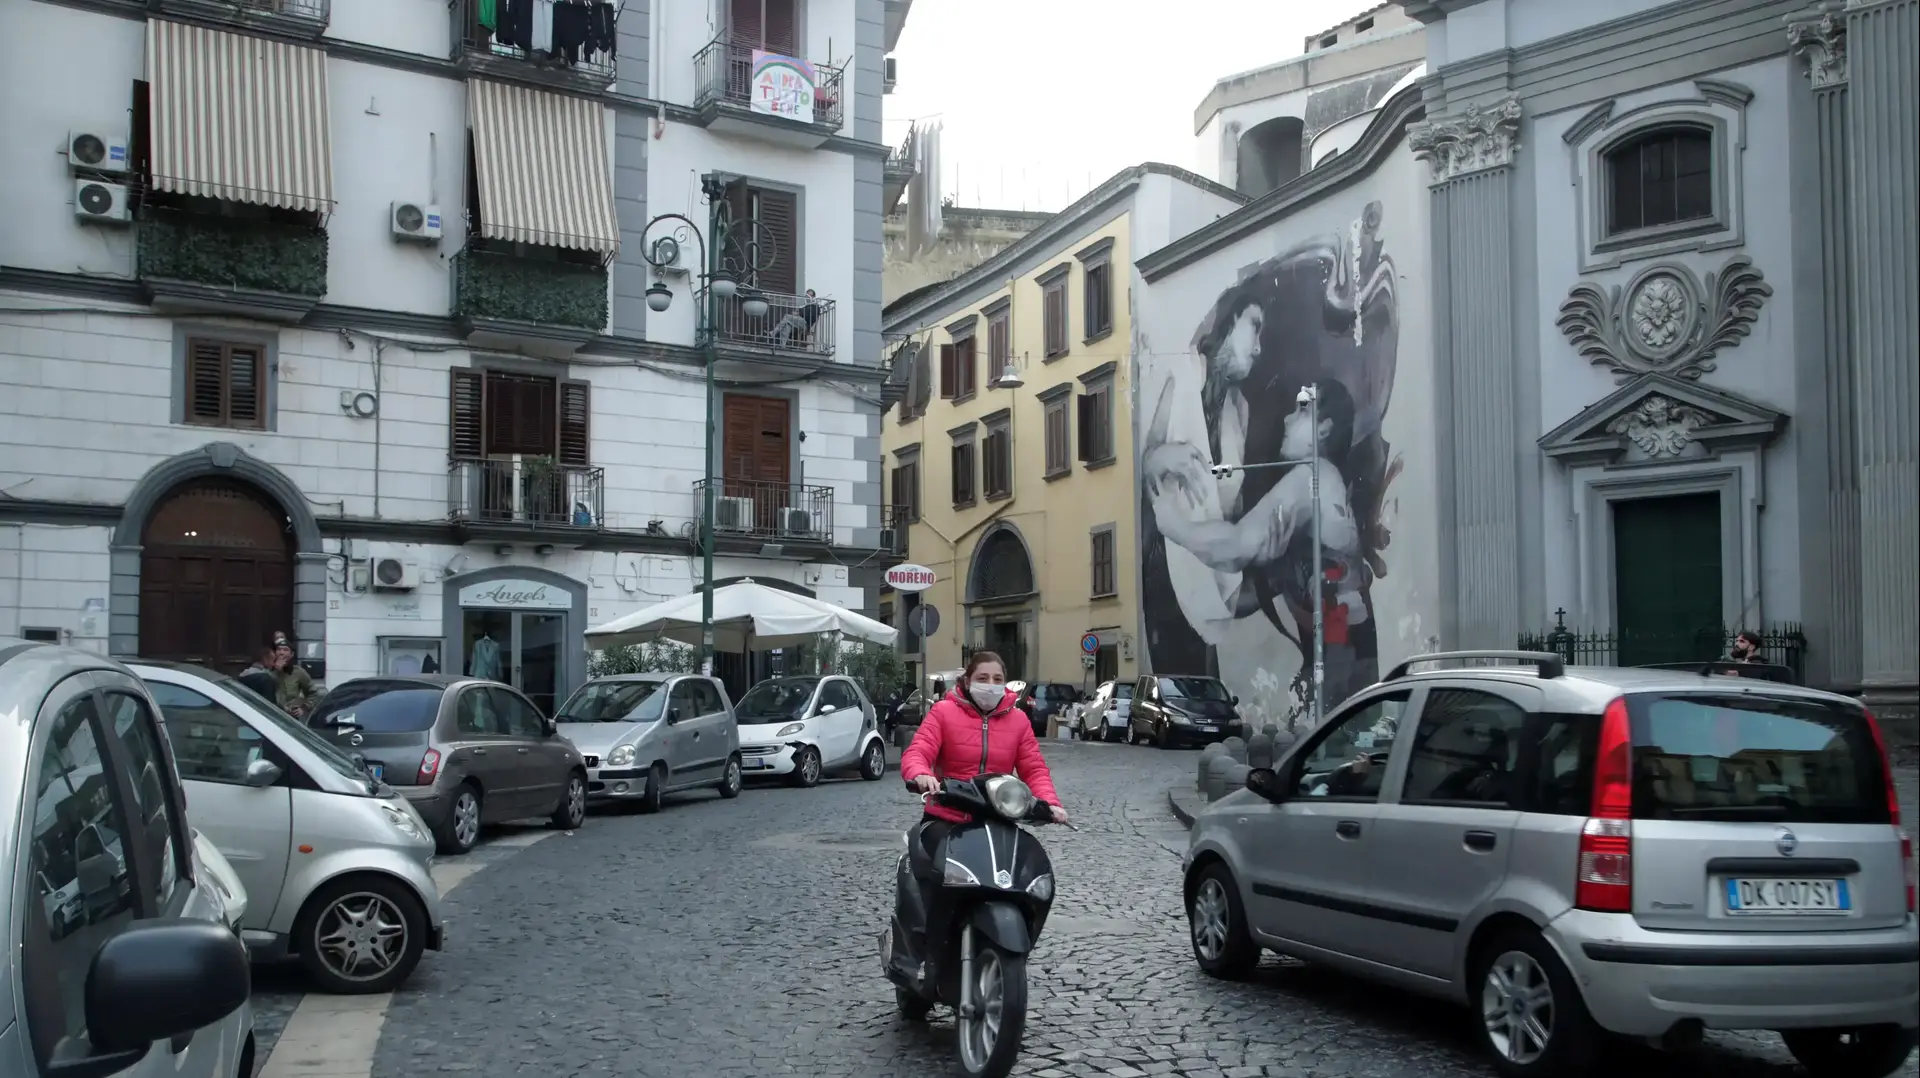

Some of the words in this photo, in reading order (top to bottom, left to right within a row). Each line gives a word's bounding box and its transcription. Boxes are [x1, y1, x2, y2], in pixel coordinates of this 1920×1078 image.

[888, 571, 935, 584] MORENO
[476, 584, 547, 605] Angels
[1741, 881, 1768, 906] DK
[1775, 881, 1836, 906] 007SY
